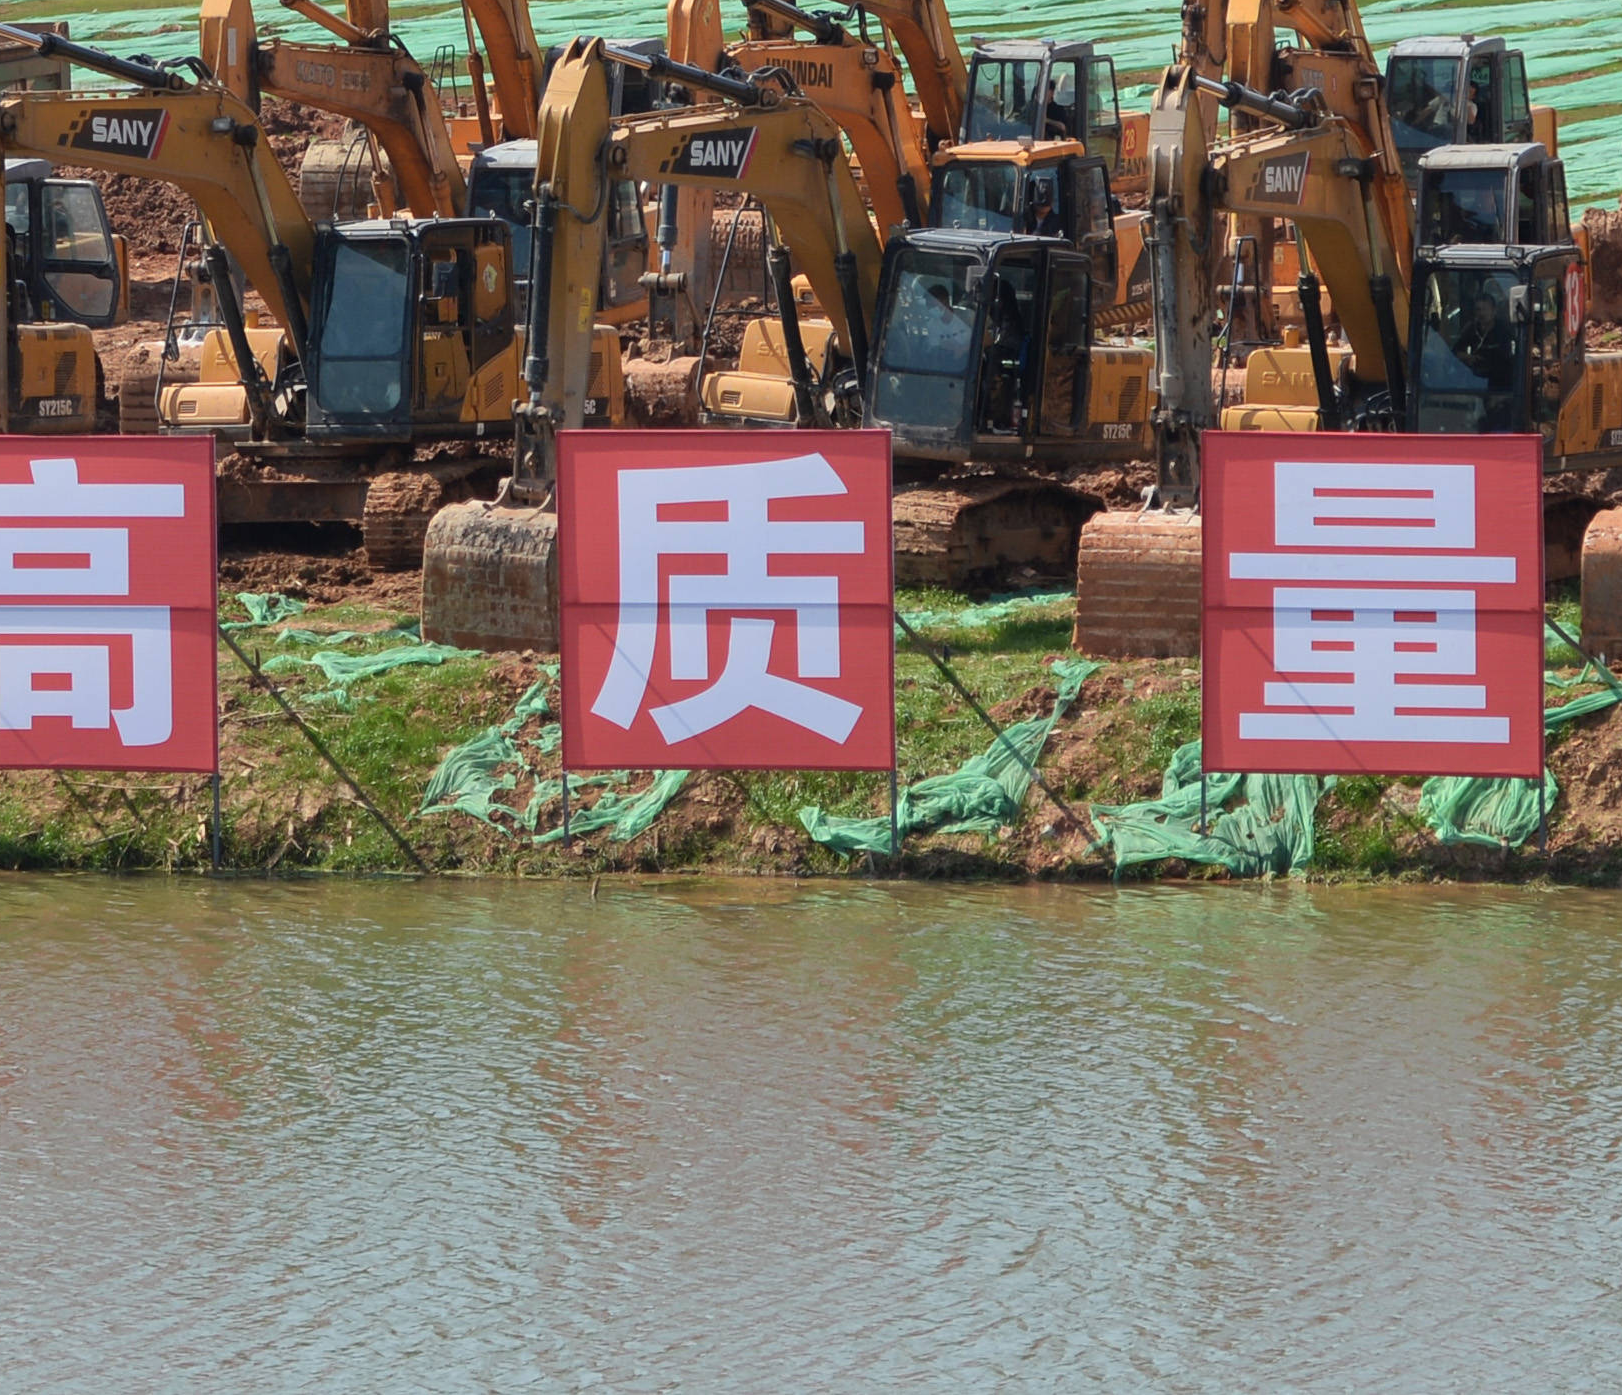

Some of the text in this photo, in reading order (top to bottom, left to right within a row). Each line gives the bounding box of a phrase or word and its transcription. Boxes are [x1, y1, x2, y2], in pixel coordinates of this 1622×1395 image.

[297, 61, 335, 87] KATO
[92, 117, 153, 146] SANY
[690, 140, 744, 166] SANY
[1265, 166, 1301, 193] SANY
[39, 400, 72, 417] SY215C
[591, 453, 864, 744] 质
[1230, 462, 1516, 743] 量
